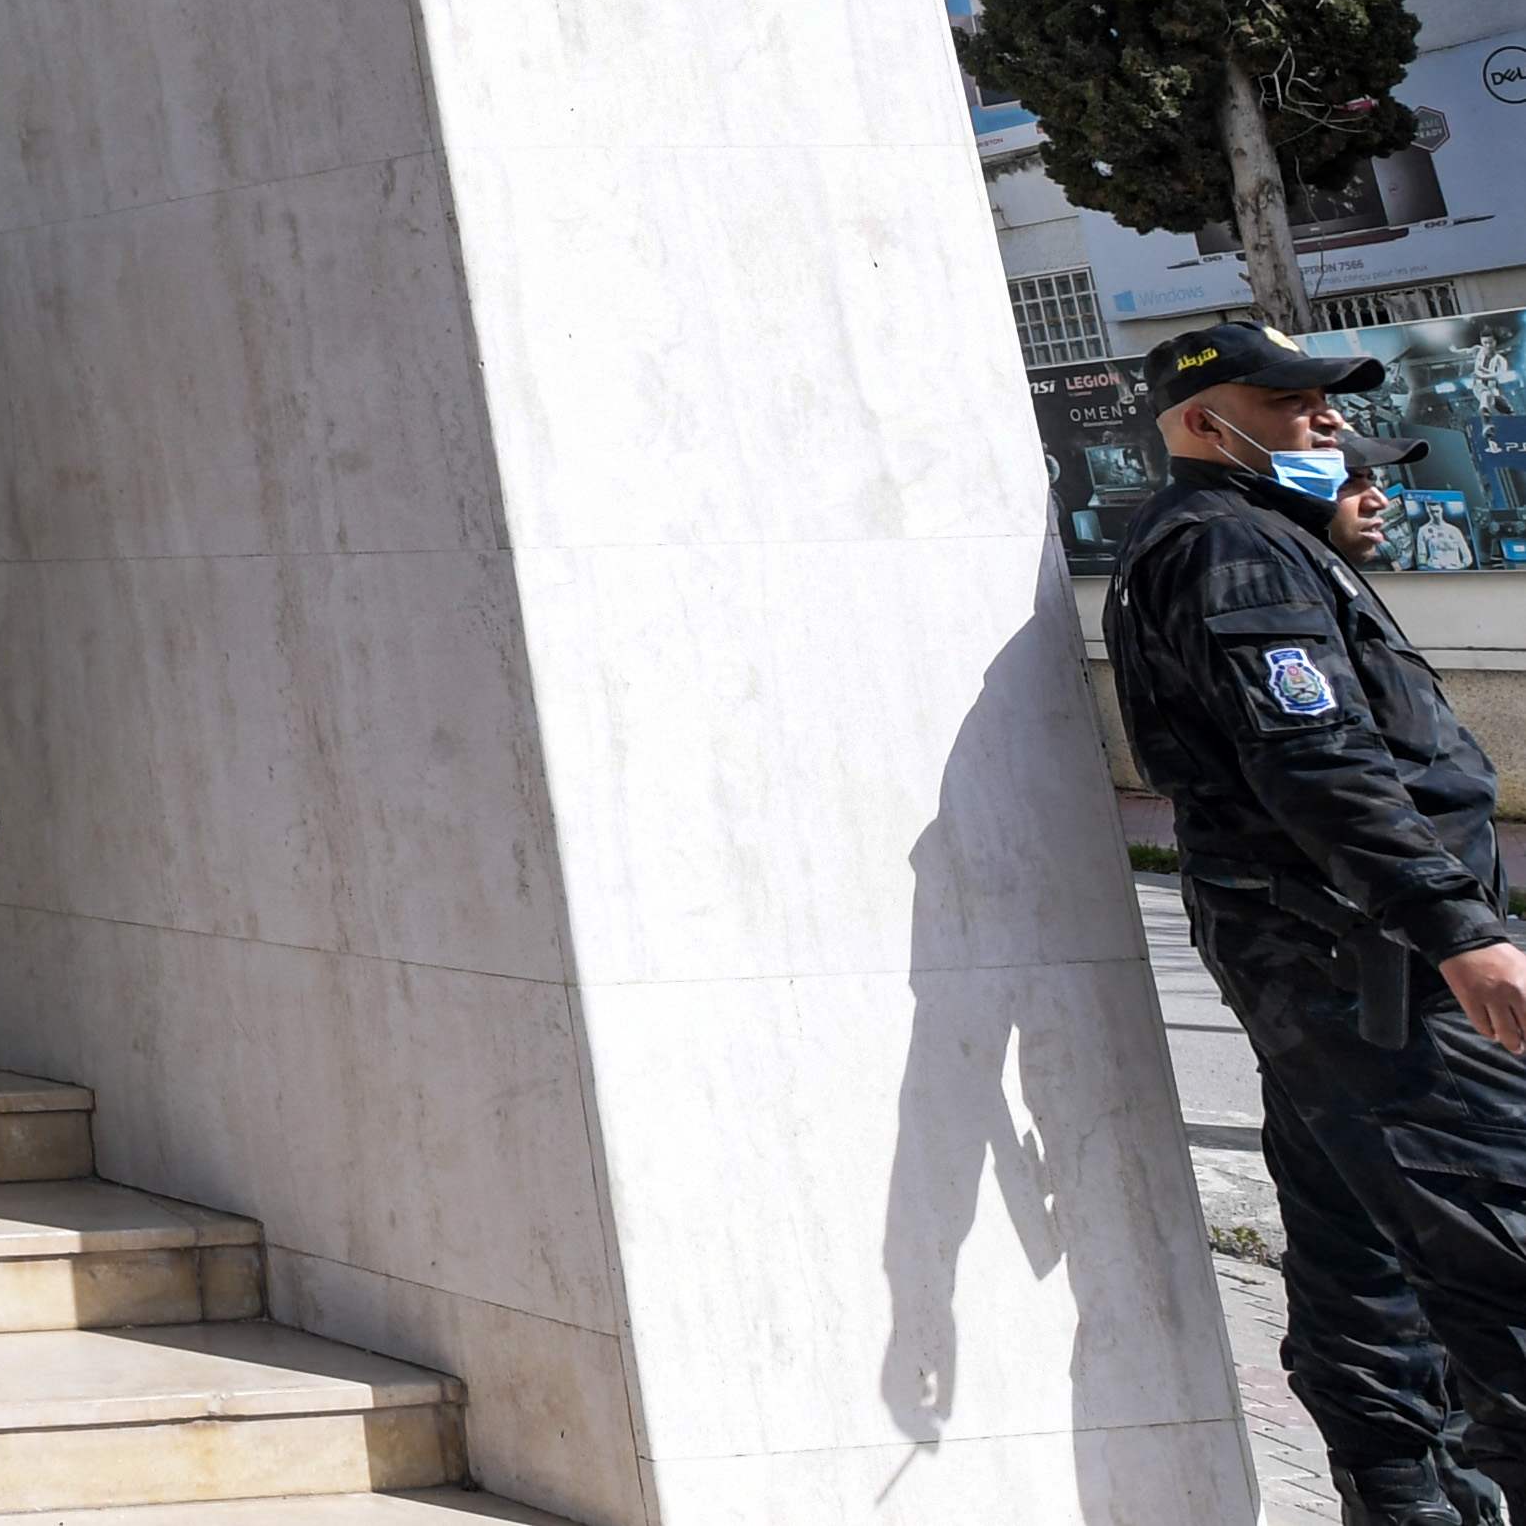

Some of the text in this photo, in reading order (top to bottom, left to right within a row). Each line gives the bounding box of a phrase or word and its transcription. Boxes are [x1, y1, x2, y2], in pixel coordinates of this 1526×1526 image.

[1138, 286, 1204, 308] Windows
[1176, 347, 1219, 371] شرطة
[1065, 373, 1121, 391] LEGION
[1070, 404, 1123, 422] OMEN
